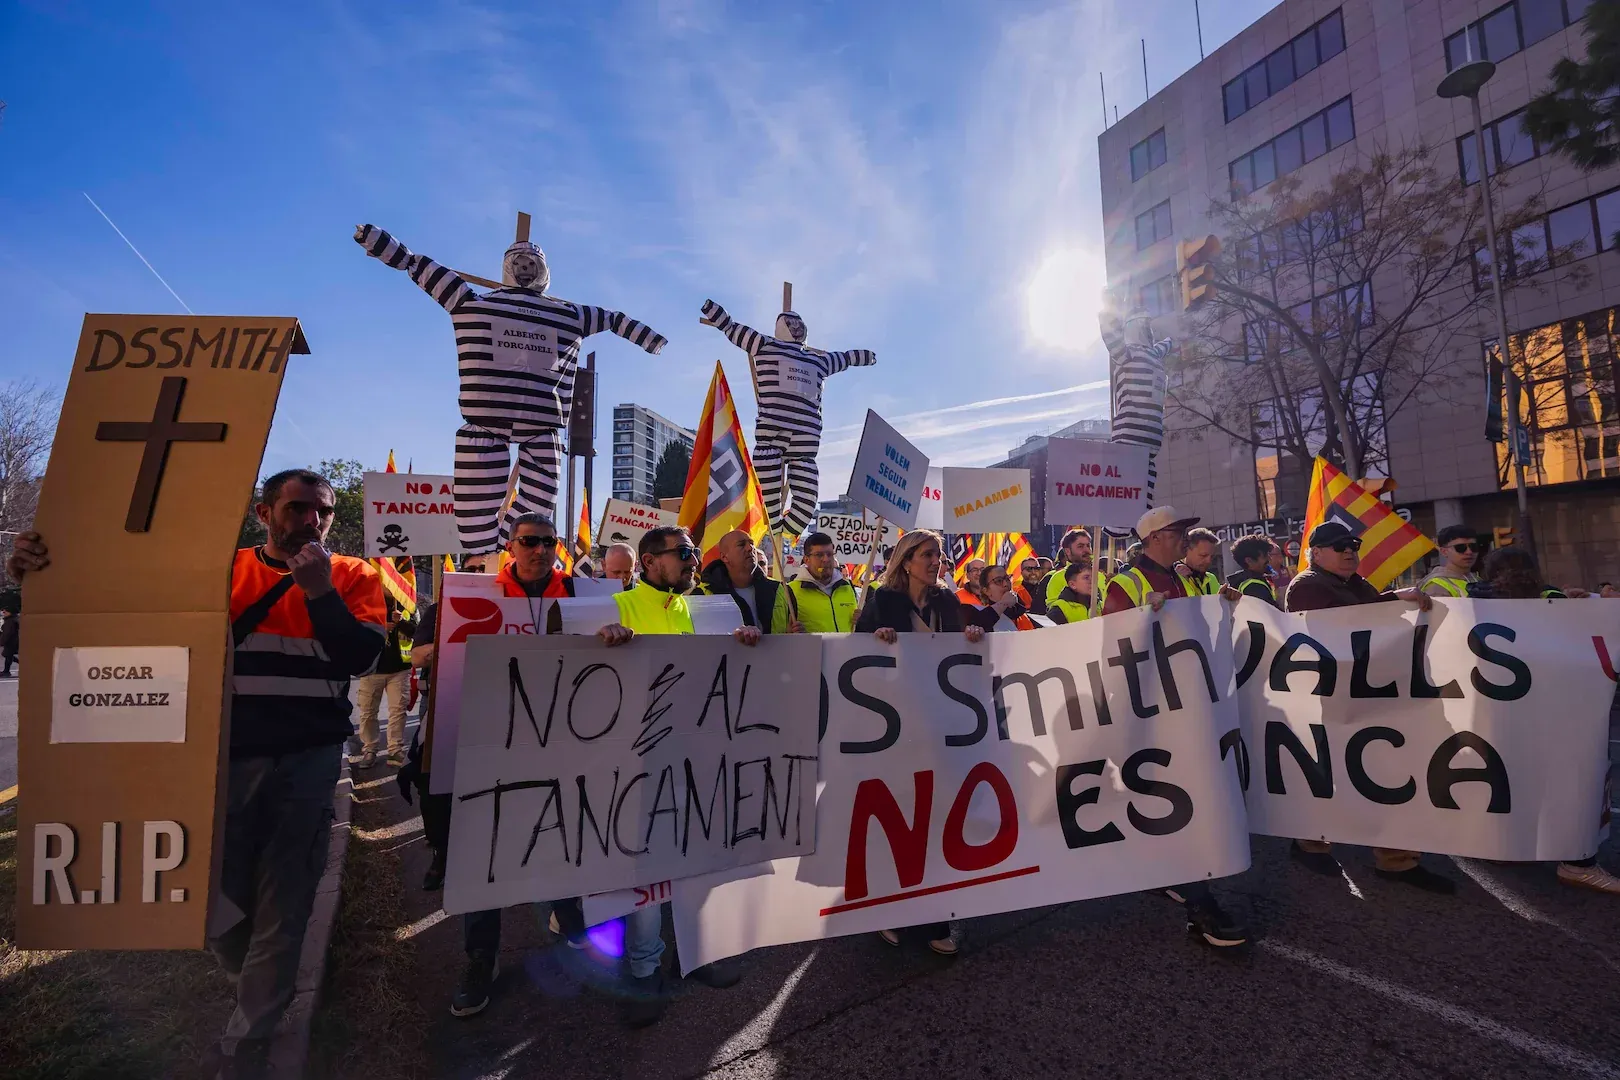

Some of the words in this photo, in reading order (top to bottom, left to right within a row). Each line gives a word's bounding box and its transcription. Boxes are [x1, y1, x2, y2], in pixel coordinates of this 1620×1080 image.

[503, 329, 547, 341] ALBERTO
[497, 341, 553, 354] FORCADELL
[789, 367, 810, 376] ISMAEL
[787, 375, 812, 385] MORENO
[885, 443, 910, 471] VOLEM
[879, 462, 907, 490] SEGUIR
[1080, 463, 1101, 476] NO
[1104, 466, 1121, 478] AL
[406, 482, 433, 494] NO
[439, 484, 454, 495] A
[865, 475, 912, 514] TREBALLANT
[1056, 482, 1142, 500] TANCAMENT
[954, 484, 1023, 518] MAAAMBO!
[629, 507, 645, 516] NO
[647, 511, 660, 521] AL
[87, 666, 154, 680] OSCAR
[818, 655, 902, 754] S
[937, 621, 1221, 747] Smith
[69, 692, 170, 707] GONZALEZ
[505, 654, 623, 750] NO
[697, 654, 780, 740] AL
[459, 754, 818, 884] TANCAMENT
[844, 761, 1019, 902] NO
[1056, 748, 1194, 850] ES
